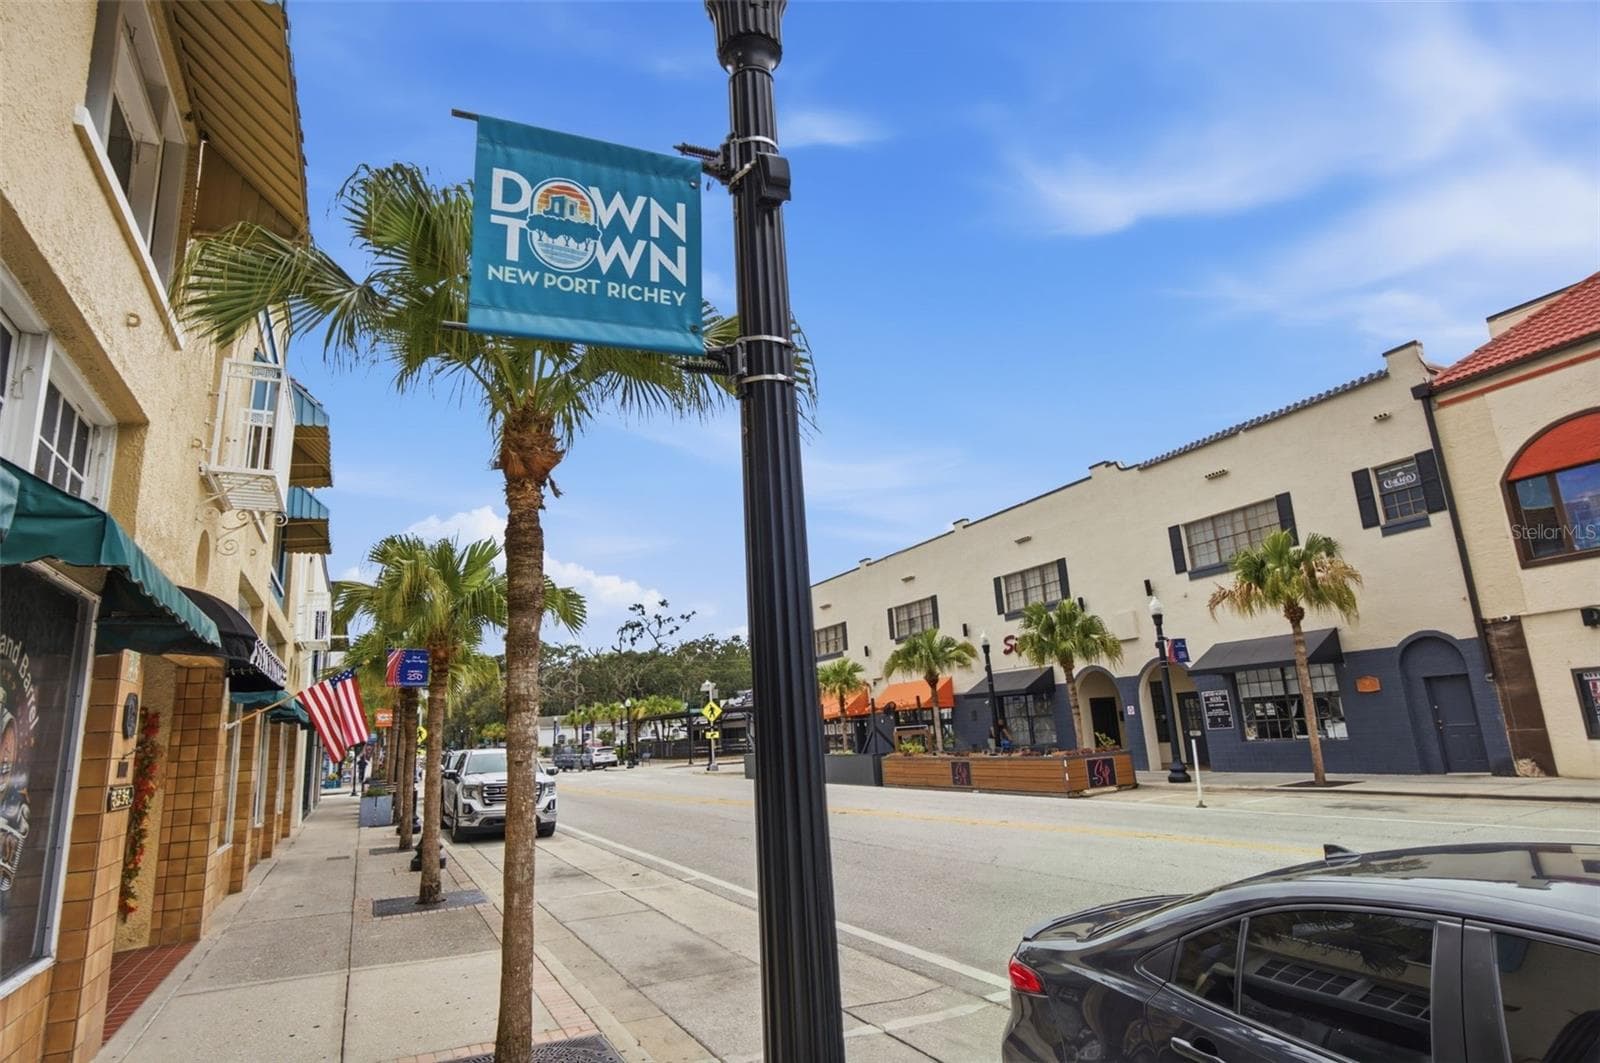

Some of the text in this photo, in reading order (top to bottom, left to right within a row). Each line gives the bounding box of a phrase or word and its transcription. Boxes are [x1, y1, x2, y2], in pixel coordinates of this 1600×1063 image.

[491, 167, 686, 243] DOWN
[487, 263, 687, 307] NEW PORT RICHEY
[490, 214, 687, 287] TOWN
[0, 634, 39, 730] and Barrel
